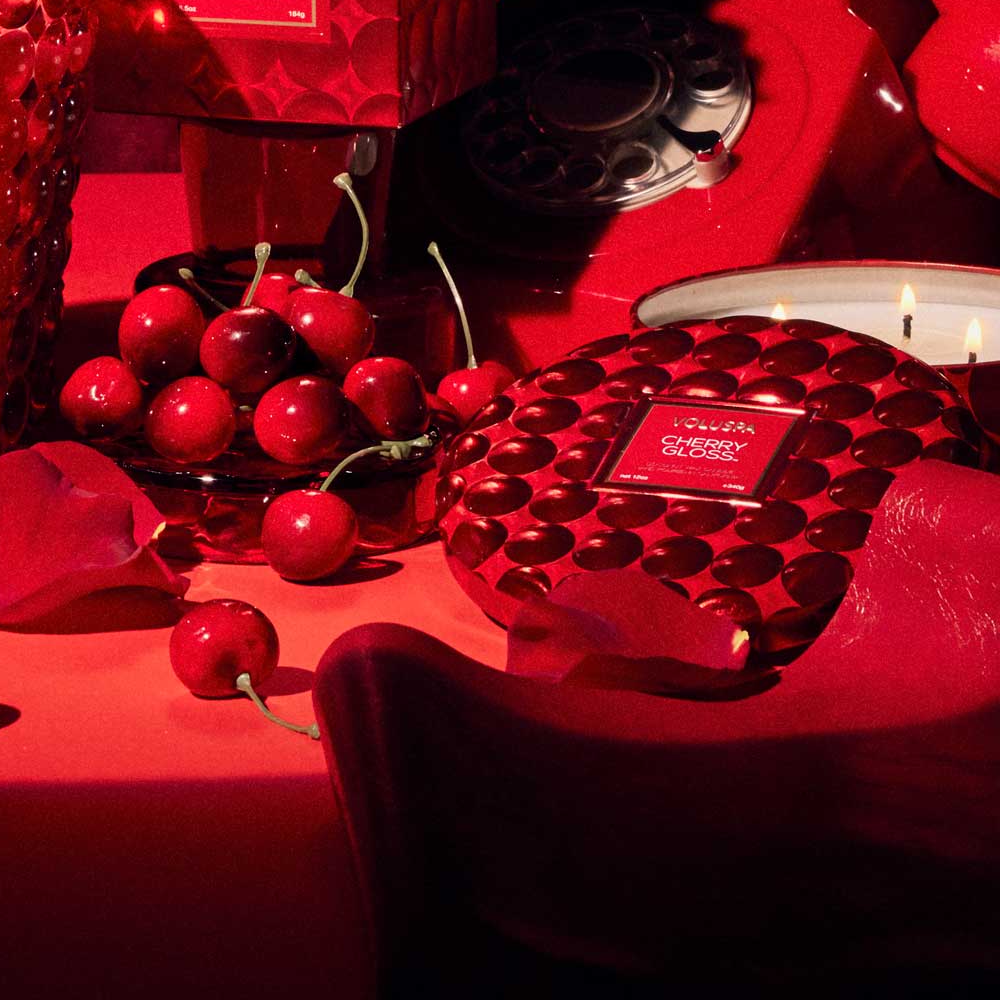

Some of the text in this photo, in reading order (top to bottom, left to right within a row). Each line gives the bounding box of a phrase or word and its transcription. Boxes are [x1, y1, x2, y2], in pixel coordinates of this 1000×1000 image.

[288, 10, 305, 19] 184g
[673, 416, 756, 434] VOLUSPA
[661, 435, 748, 452] CHERRY
